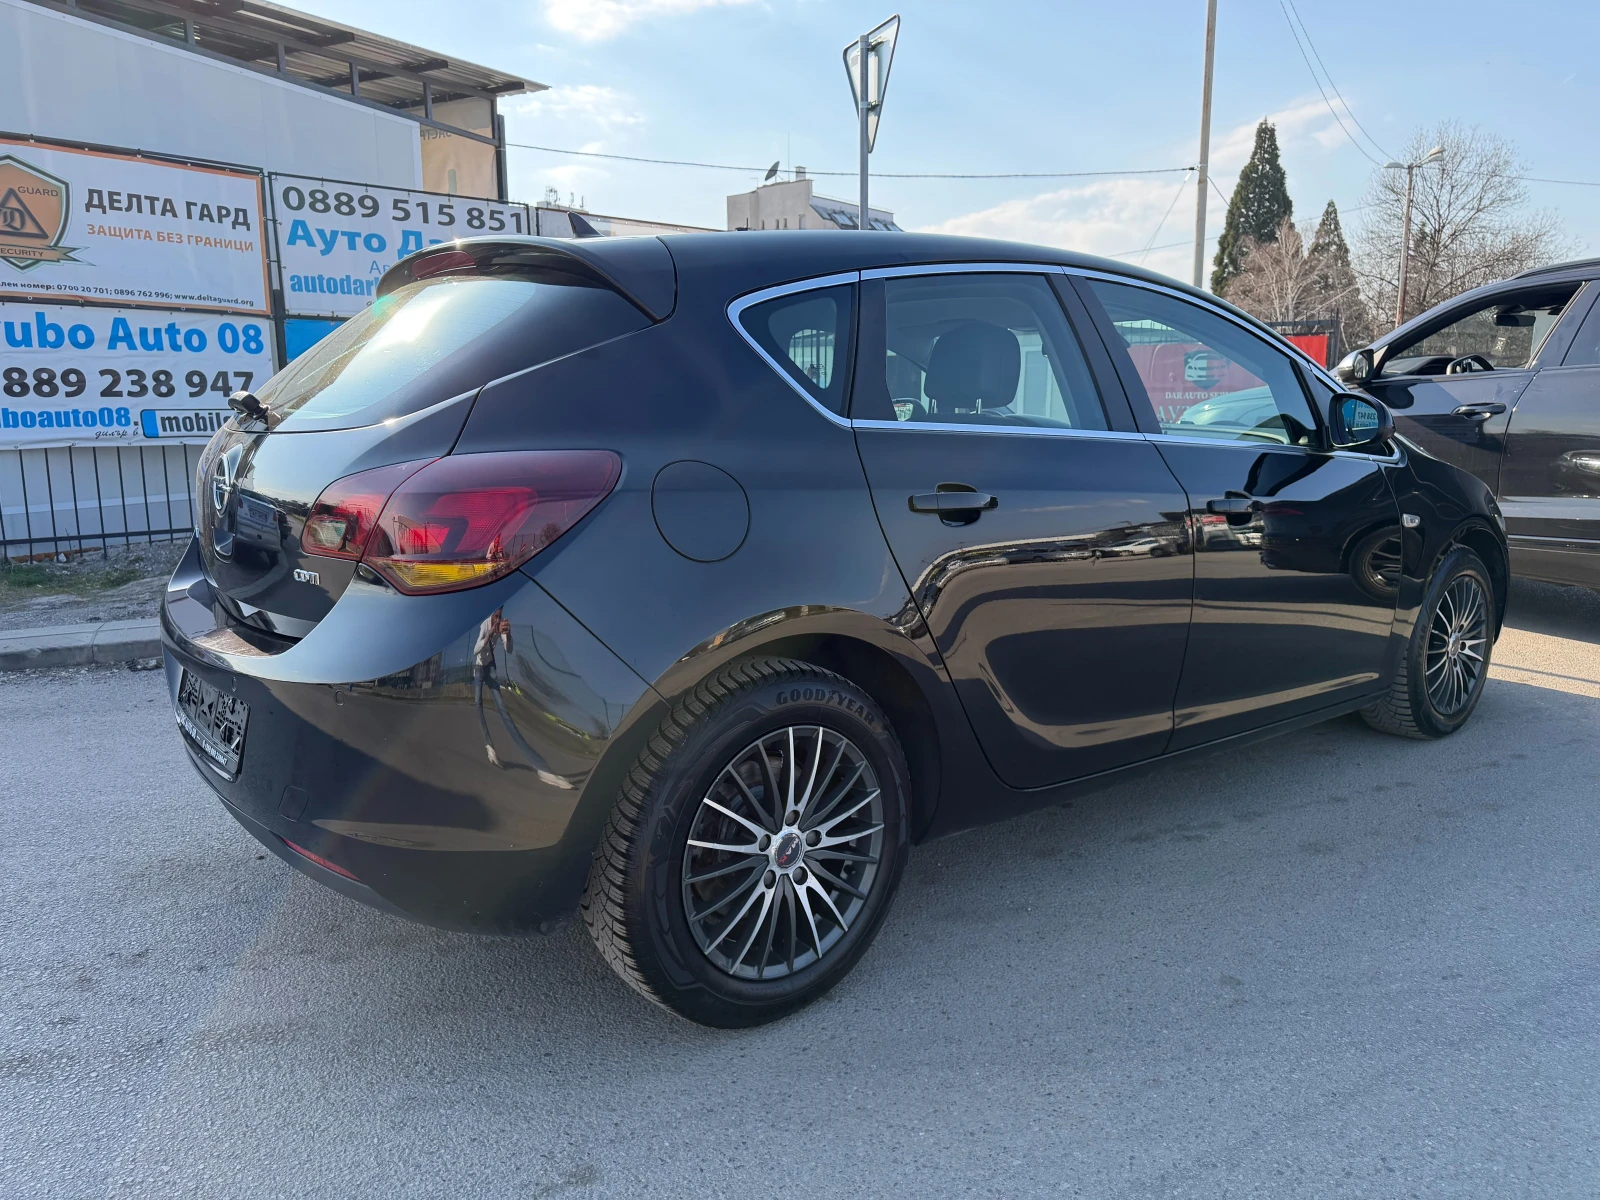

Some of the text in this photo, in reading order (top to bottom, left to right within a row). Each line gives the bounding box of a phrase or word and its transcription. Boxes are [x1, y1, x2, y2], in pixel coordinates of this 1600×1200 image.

[18, 186, 59, 197] GUARD
[85, 188, 251, 231] ДЕЛТА ГАРД
[282, 186, 523, 234] 0889 515 851
[87, 223, 254, 253] ЗАЩИТА БЕЗ ГРАНИЦИ
[287, 219, 387, 257] Ауто
[20, 282, 55, 291] номер:
[57, 284, 79, 292] 0700
[94, 287, 113, 295] 701;
[114, 288, 135, 296] 0896
[137, 290, 153, 298] 762
[154, 291, 173, 300] 996;
[174, 293, 254, 307] www.deltaguard.org
[0, 312, 264, 355] ubo Auto 08
[2, 367, 254, 399] 889 238 947
[1165, 391, 1183, 400] DAR
[1183, 391, 1208, 400] AUTO
[0, 406, 139, 429] boauto08.
[293, 568, 320, 586] CDTI
[775, 687, 877, 727] GOODYEAR
